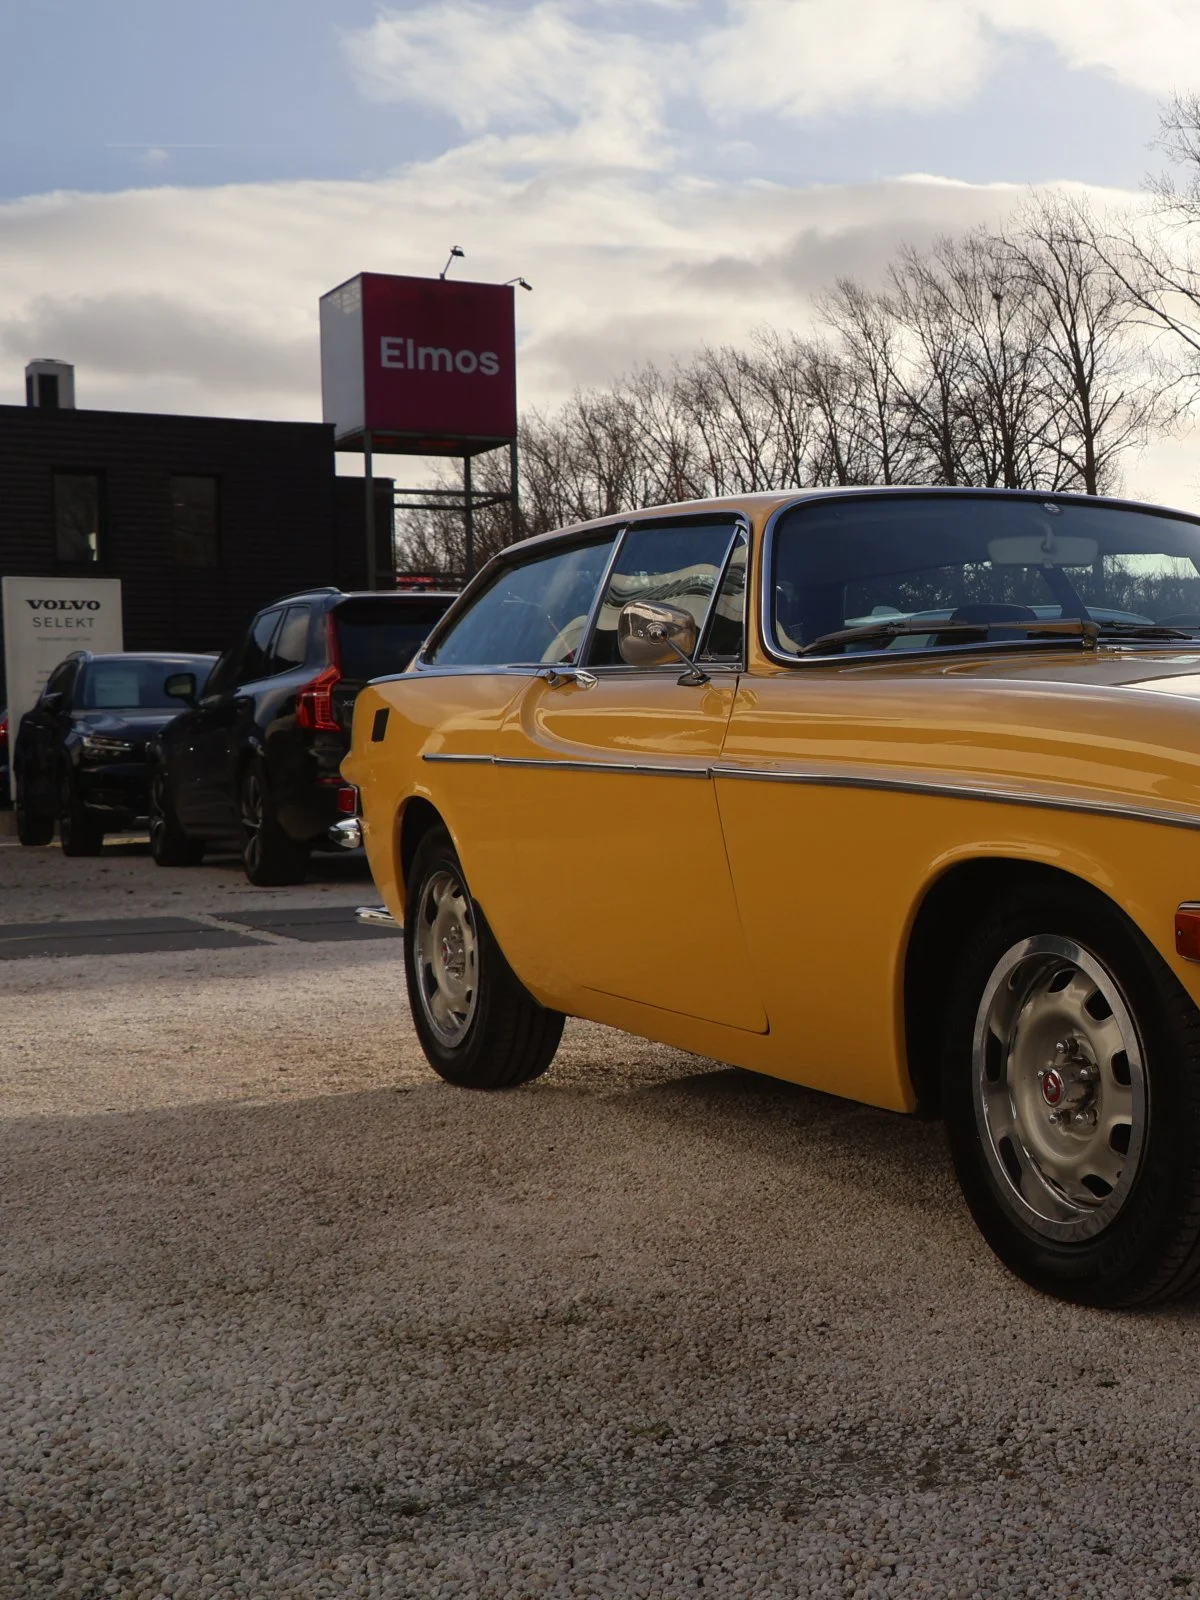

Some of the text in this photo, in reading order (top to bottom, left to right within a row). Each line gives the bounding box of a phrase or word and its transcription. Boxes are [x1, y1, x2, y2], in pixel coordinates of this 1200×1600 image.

[380, 335, 500, 376] Elmos
[25, 599, 101, 611] VOLVO
[32, 616, 95, 628] SELEKT
